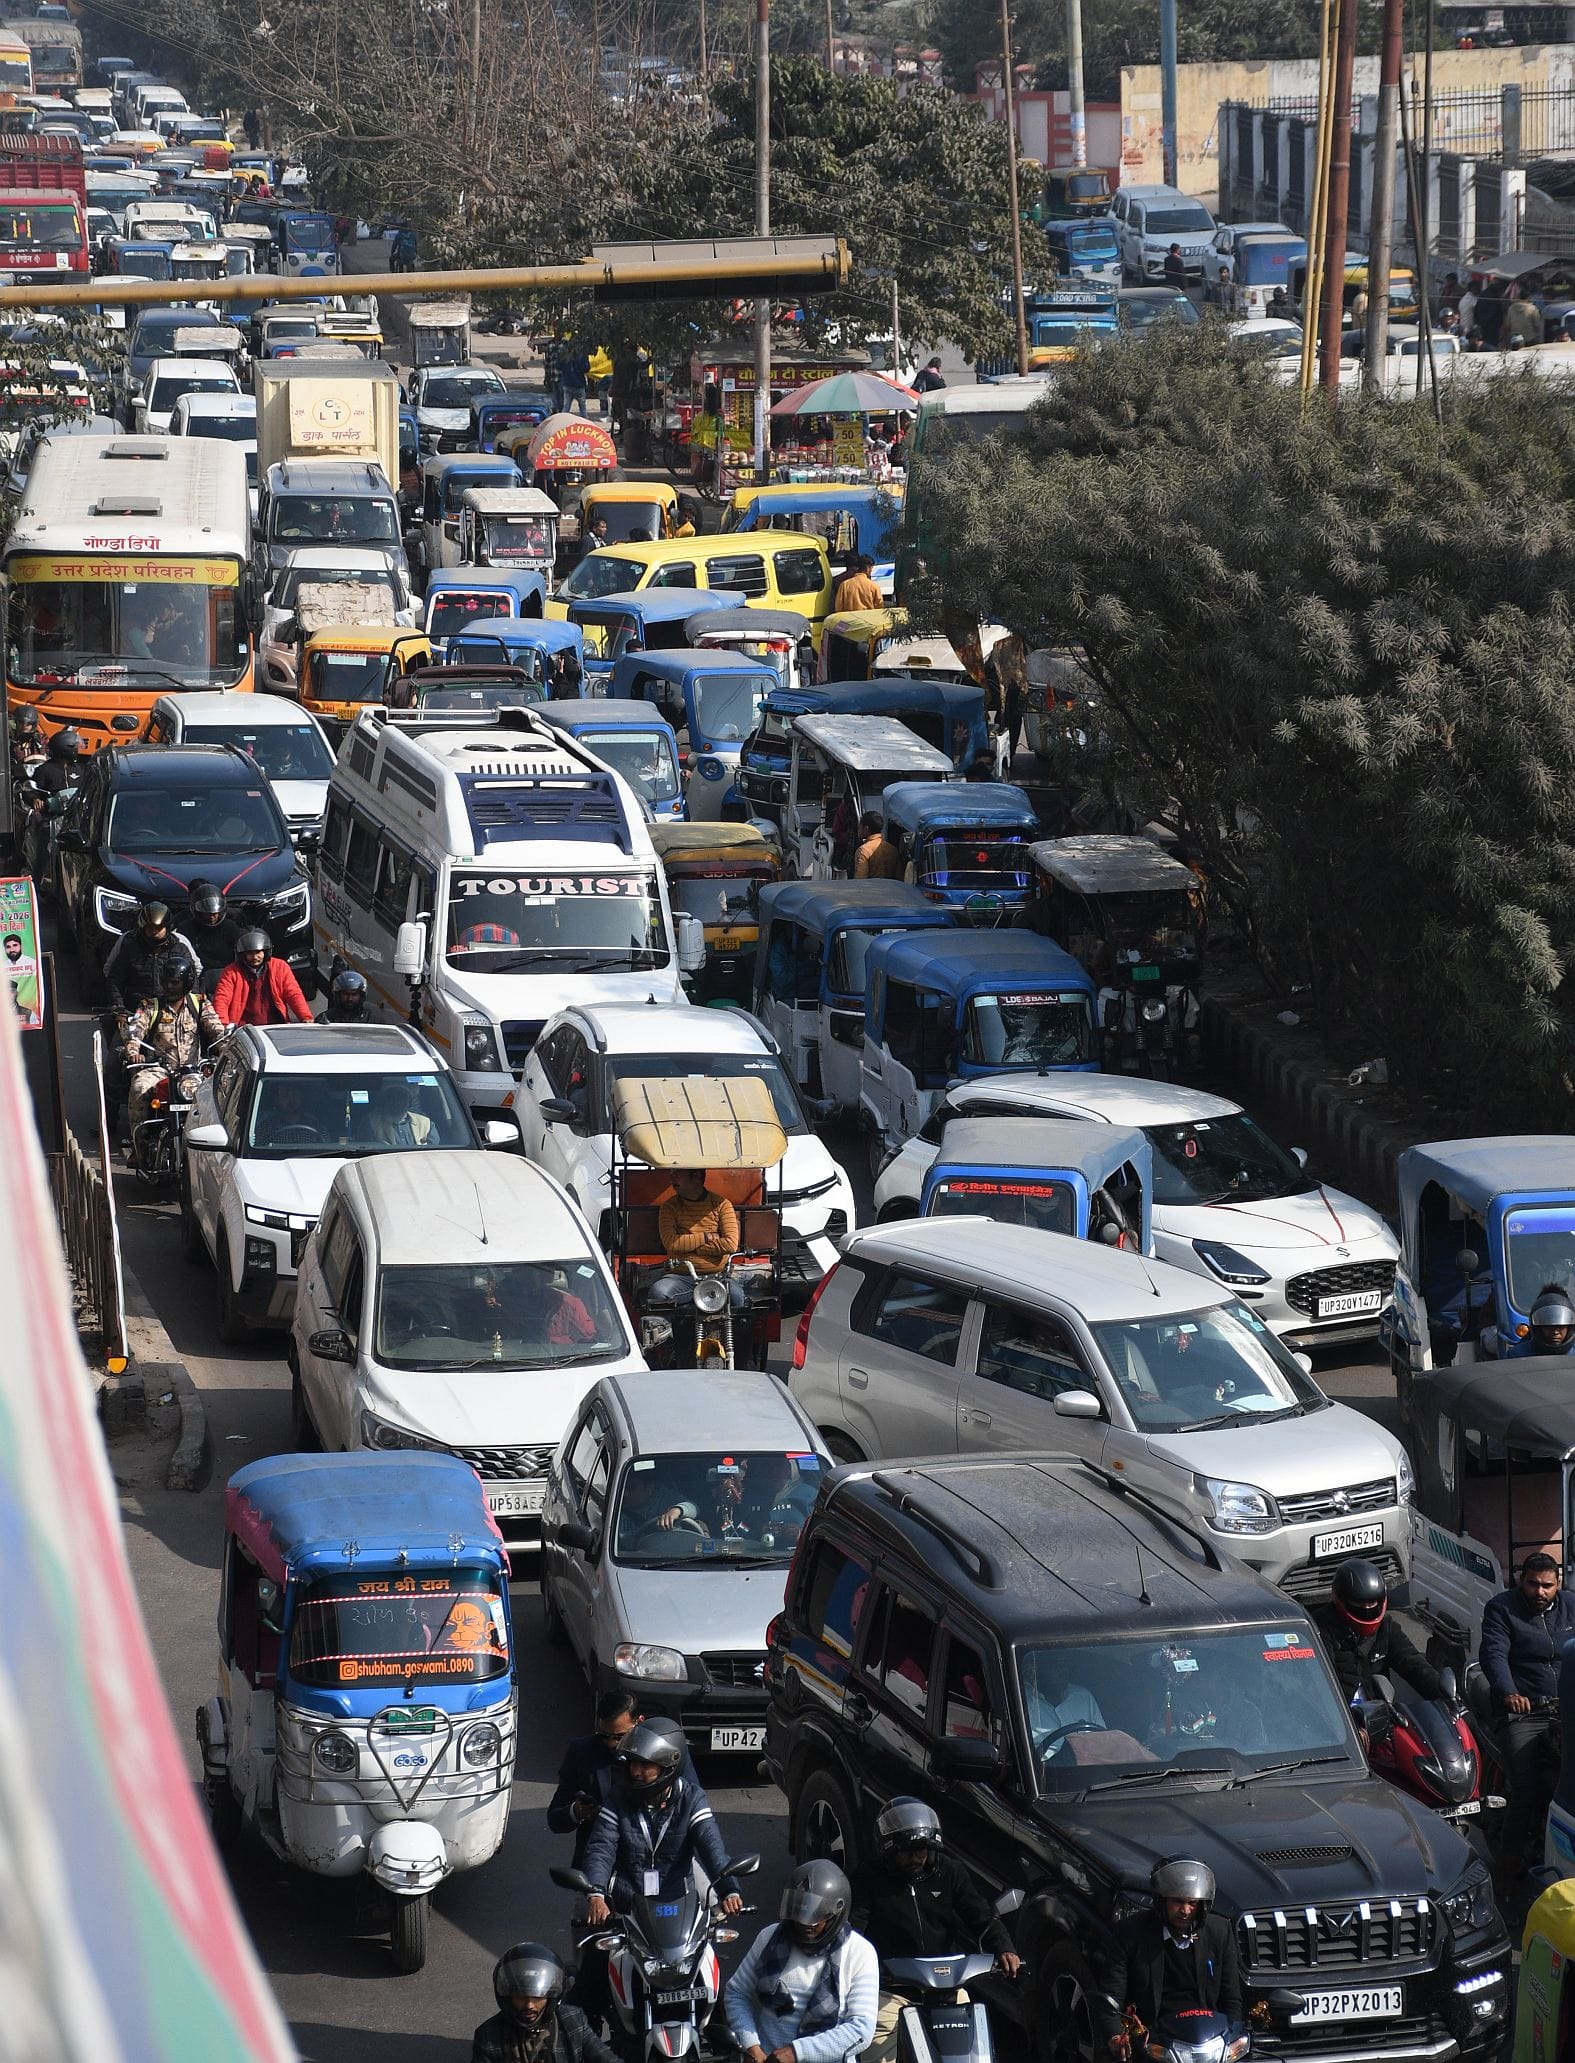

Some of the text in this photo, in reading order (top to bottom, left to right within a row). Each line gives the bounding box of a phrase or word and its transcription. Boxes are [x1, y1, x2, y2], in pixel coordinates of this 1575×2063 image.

[556, 428, 568, 440] IN
[52, 561, 195, 579] उत्तर प्रदेश परिवहन
[457, 877, 648, 896] TOURIST
[8, 911, 30, 920] 2026
[1031, 994, 1059, 1002] BAJAJ
[1321, 1529, 1381, 1552] UP32QK5216
[357, 1577, 450, 1593] जय श्री राम
[357, 1658, 474, 1678] shubham_goswami_0890
[722, 1731, 758, 1747] UP42
[655, 1905, 679, 1917] SBI
